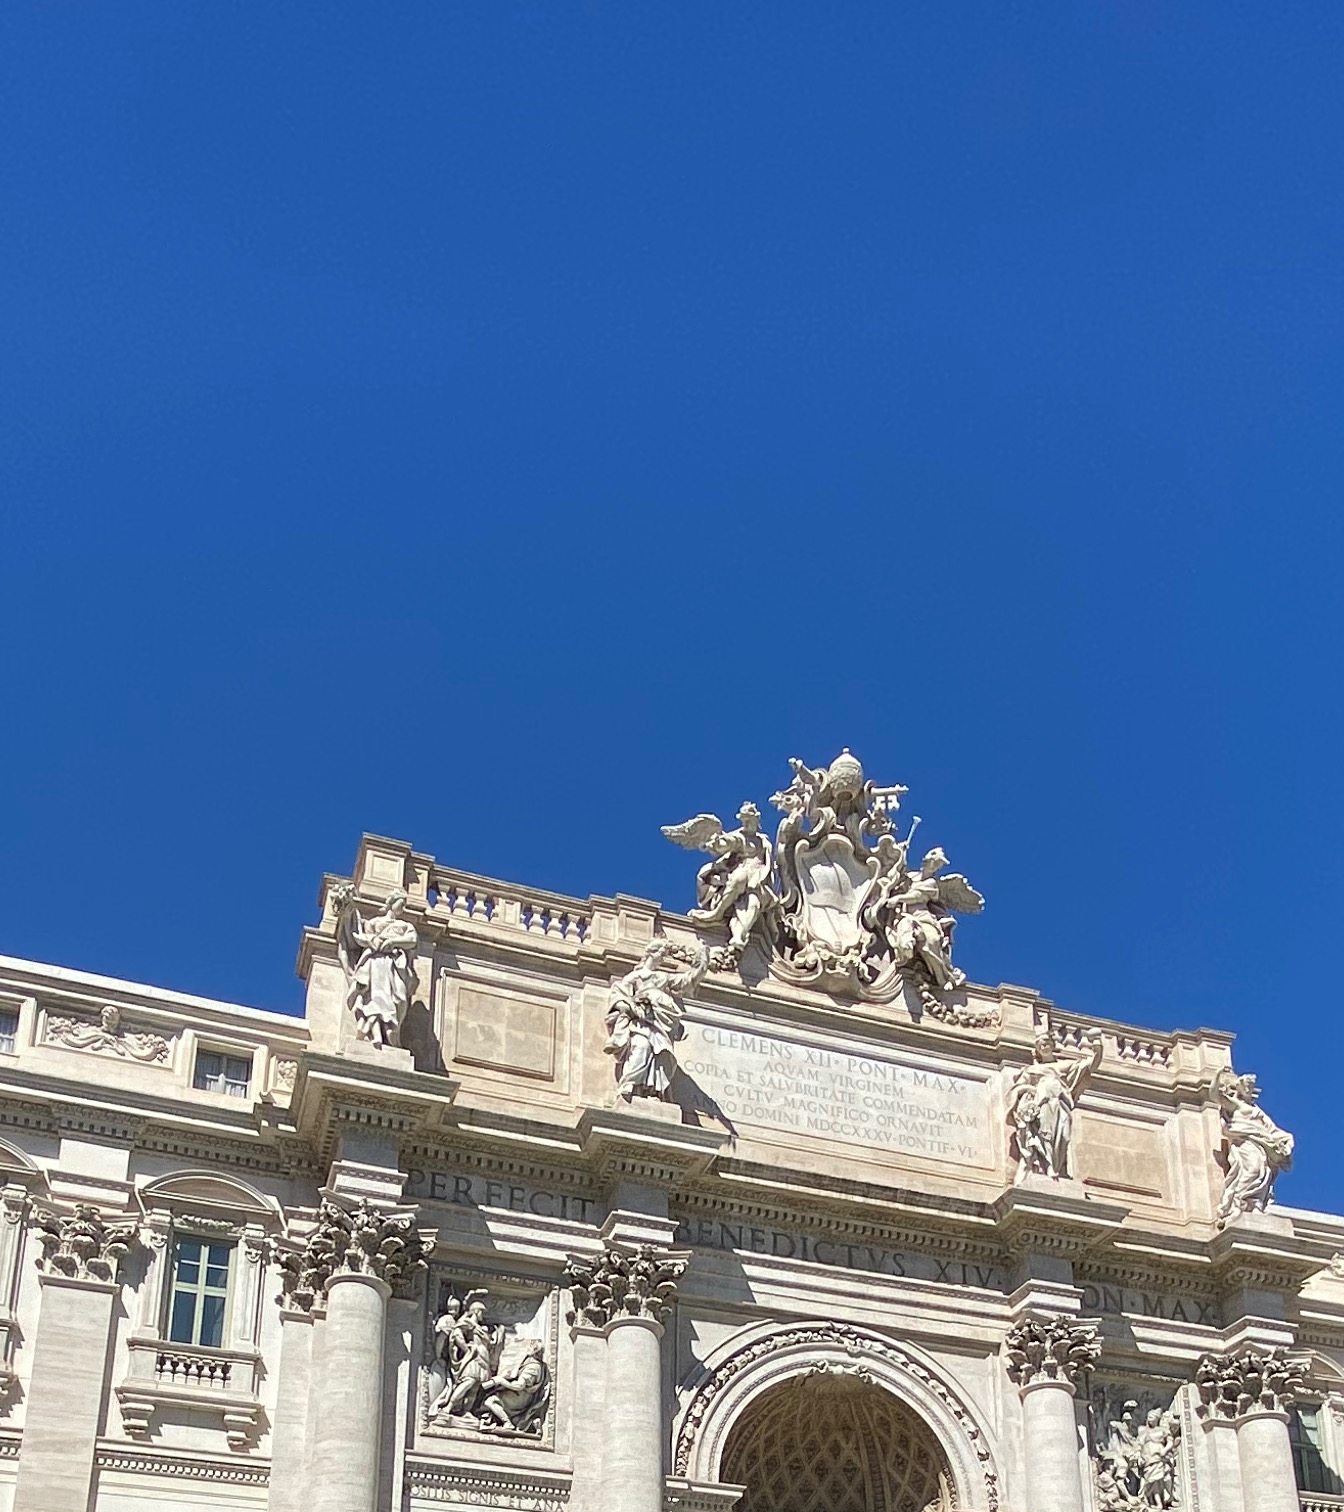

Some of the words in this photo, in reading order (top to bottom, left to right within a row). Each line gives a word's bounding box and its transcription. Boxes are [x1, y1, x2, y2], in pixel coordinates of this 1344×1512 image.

[701, 1028, 793, 1059] CLEMENS
[683, 1060, 729, 1081] COPIA
[737, 1071, 752, 1084] ET
[759, 1074, 855, 1104] SALVBRITATE
[862, 1096, 978, 1128] COMMENDATAM
[763, 1061, 819, 1082] AQVAM
[830, 1074, 905, 1098] VIRGINEM
[692, 1096, 736, 1113] ANNO
[741, 1104, 800, 1126] DOMINI
[723, 1084, 774, 1102] CVLTV
[784, 1096, 870, 1123] MAGNIFICO
[876, 1114, 943, 1137] ORNAVIT
[407, 1168, 594, 1222] PERFECIT
[674, 1214, 906, 1277] BENEDICTVS
[411, 1484, 451, 1500] OSITIS
